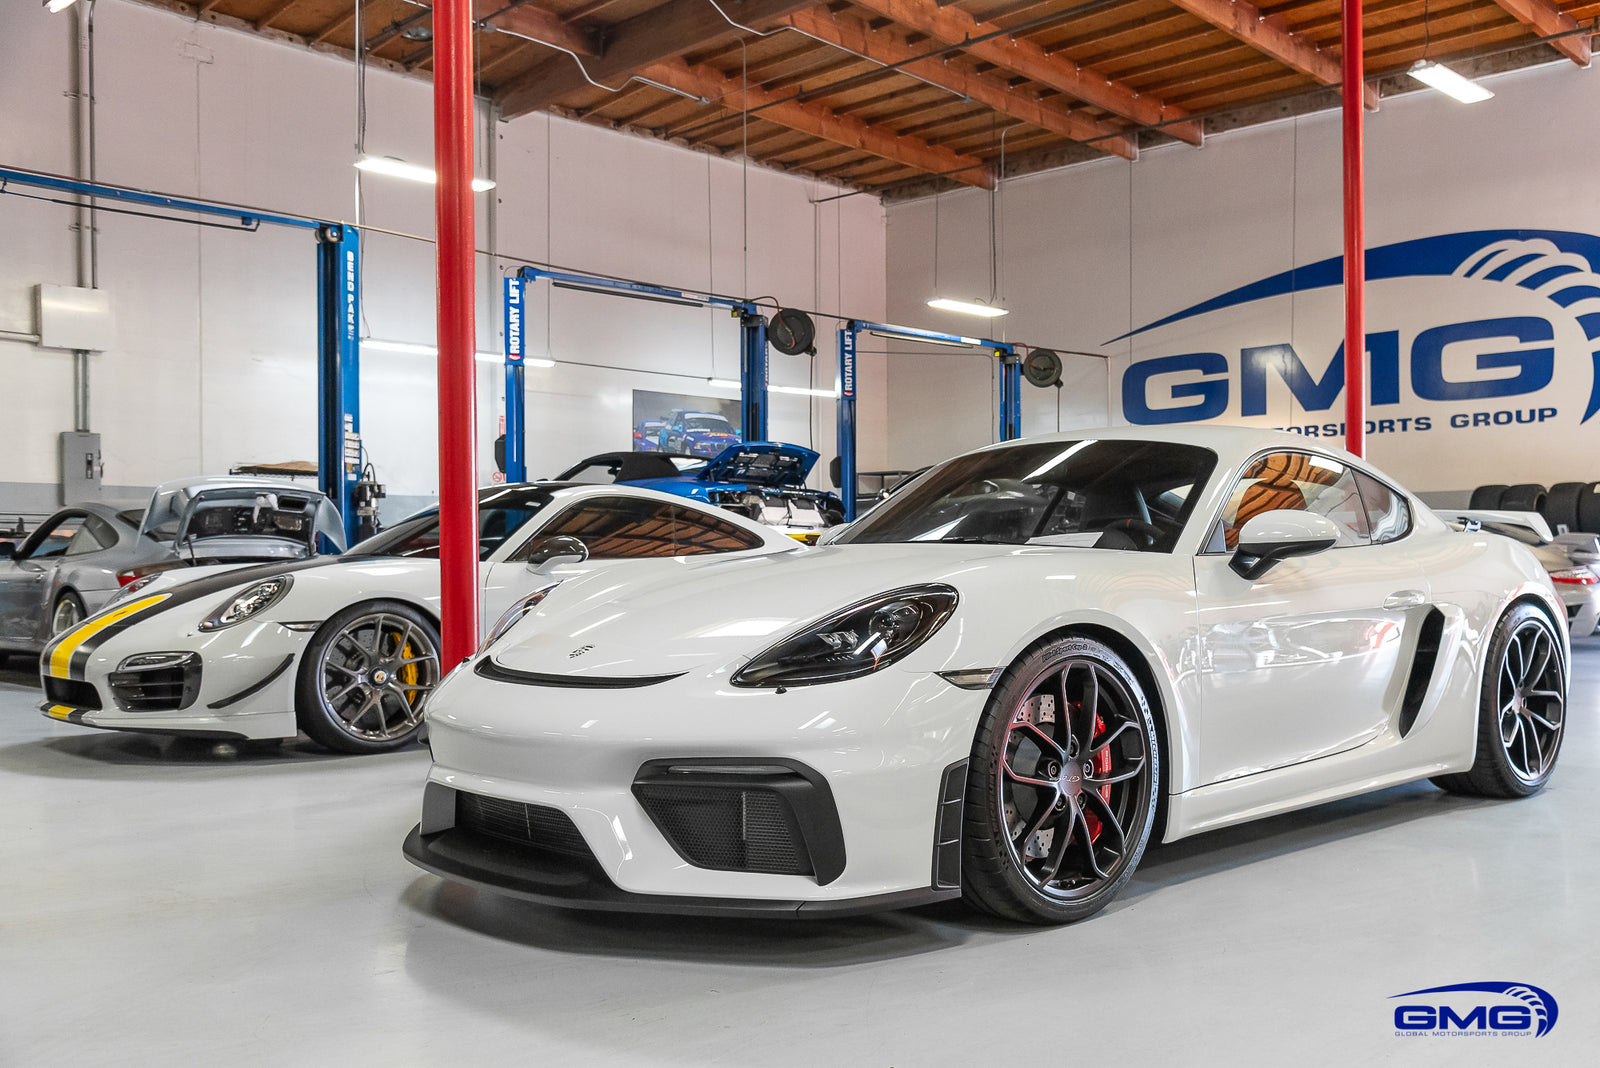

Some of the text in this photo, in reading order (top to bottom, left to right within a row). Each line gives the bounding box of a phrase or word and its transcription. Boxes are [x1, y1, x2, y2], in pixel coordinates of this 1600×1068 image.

[509, 278, 520, 354] ROTARY LIFT
[844, 331, 852, 390] ROTARY LIFT
[1122, 316, 1555, 425] GMG
[1449, 407, 1558, 428] GROUP
